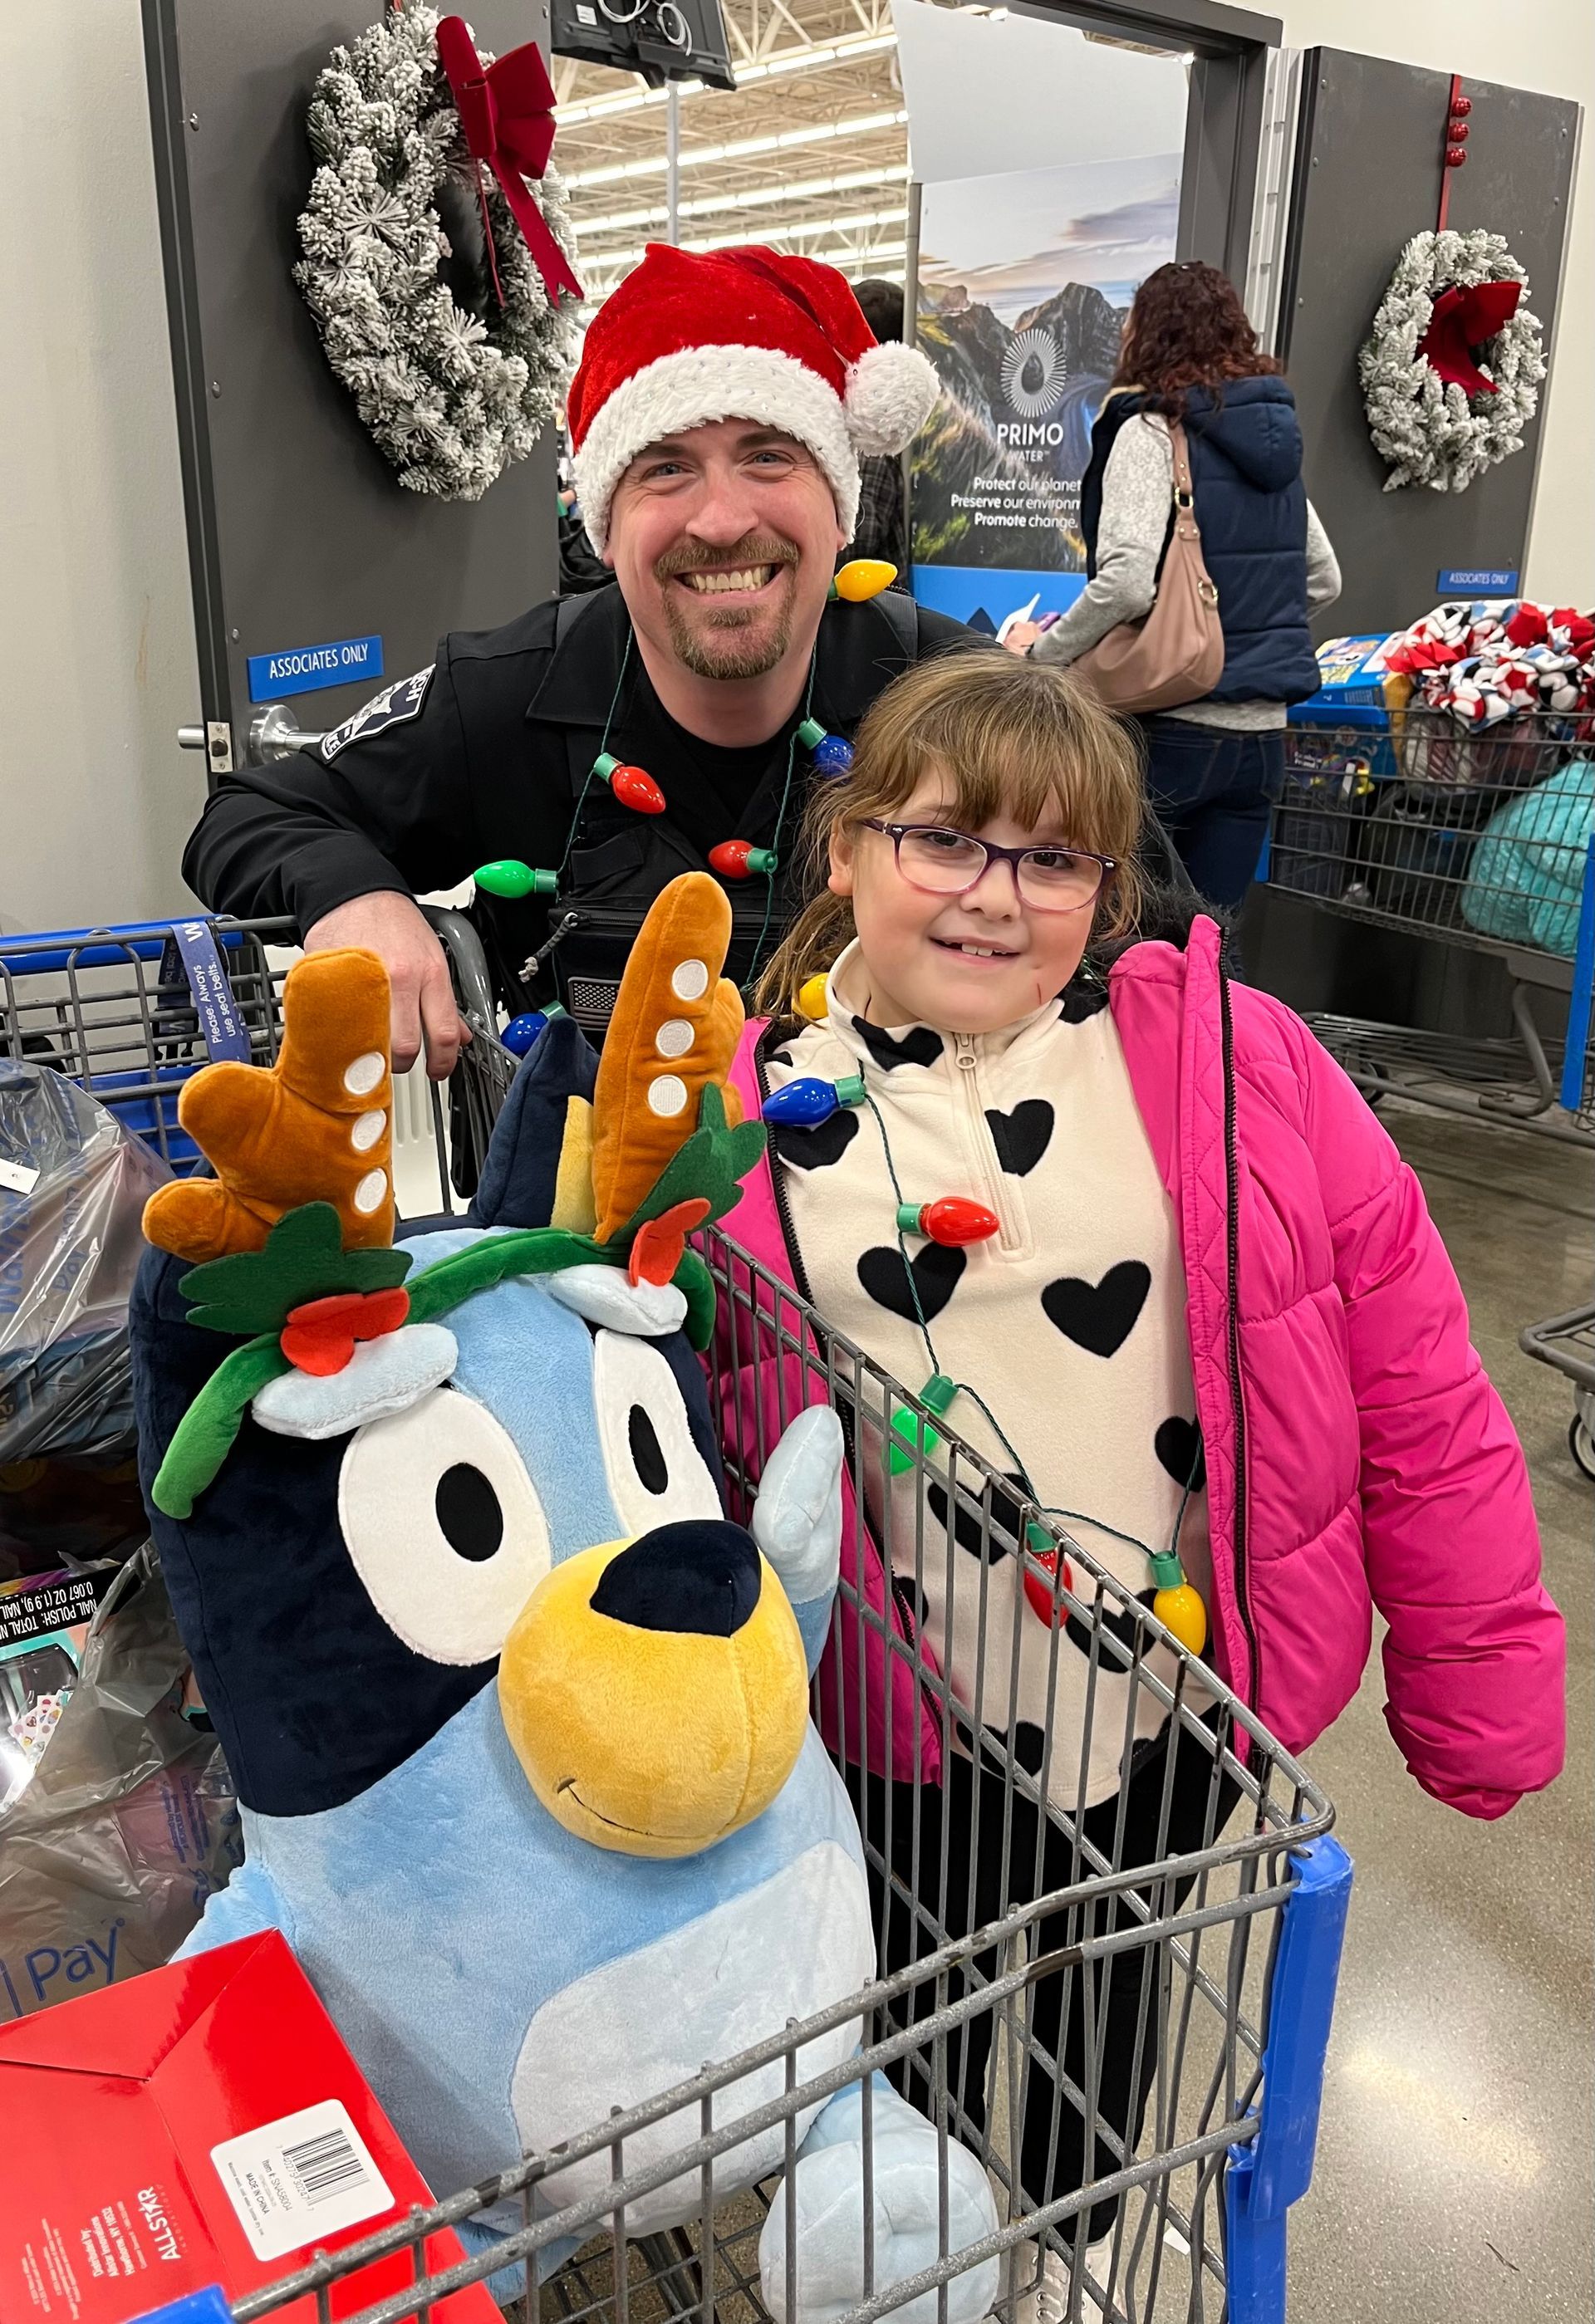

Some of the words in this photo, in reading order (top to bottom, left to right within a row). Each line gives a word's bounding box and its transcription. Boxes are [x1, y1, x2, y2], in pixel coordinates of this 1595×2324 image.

[997, 423, 1064, 446] PRIMO
[973, 477, 1016, 491] Protect
[951, 493, 1002, 508] Preserve
[1003, 498, 1023, 509] our
[974, 512, 1026, 527] Promote
[1028, 514, 1078, 532] change.
[1449, 572, 1489, 584] ASSOCIATES
[1491, 573, 1509, 585] ONLY
[269, 649, 339, 679] ASSOCIATES
[341, 643, 369, 665] ONLY
[194, 964, 212, 1003] Always
[214, 993, 230, 1018] seat
[204, 1004, 223, 1044] Please:
[224, 1018, 237, 1037] use
[35, 1590, 52, 1610] (1.9
[52, 1589, 67, 1605] OZ
[70, 1581, 93, 1601] 0.067
[0, 1601, 22, 1620] NAIL
[41, 1605, 76, 1625] POLISH:
[76, 1599, 97, 1616] NAIL
[8, 1616, 39, 1635] TOTAL
[262, 2159, 273, 2174] Item
[246, 2172, 258, 2190] MADE
[253, 2188, 262, 2197] IN
[257, 2195, 271, 2216] CHINA
